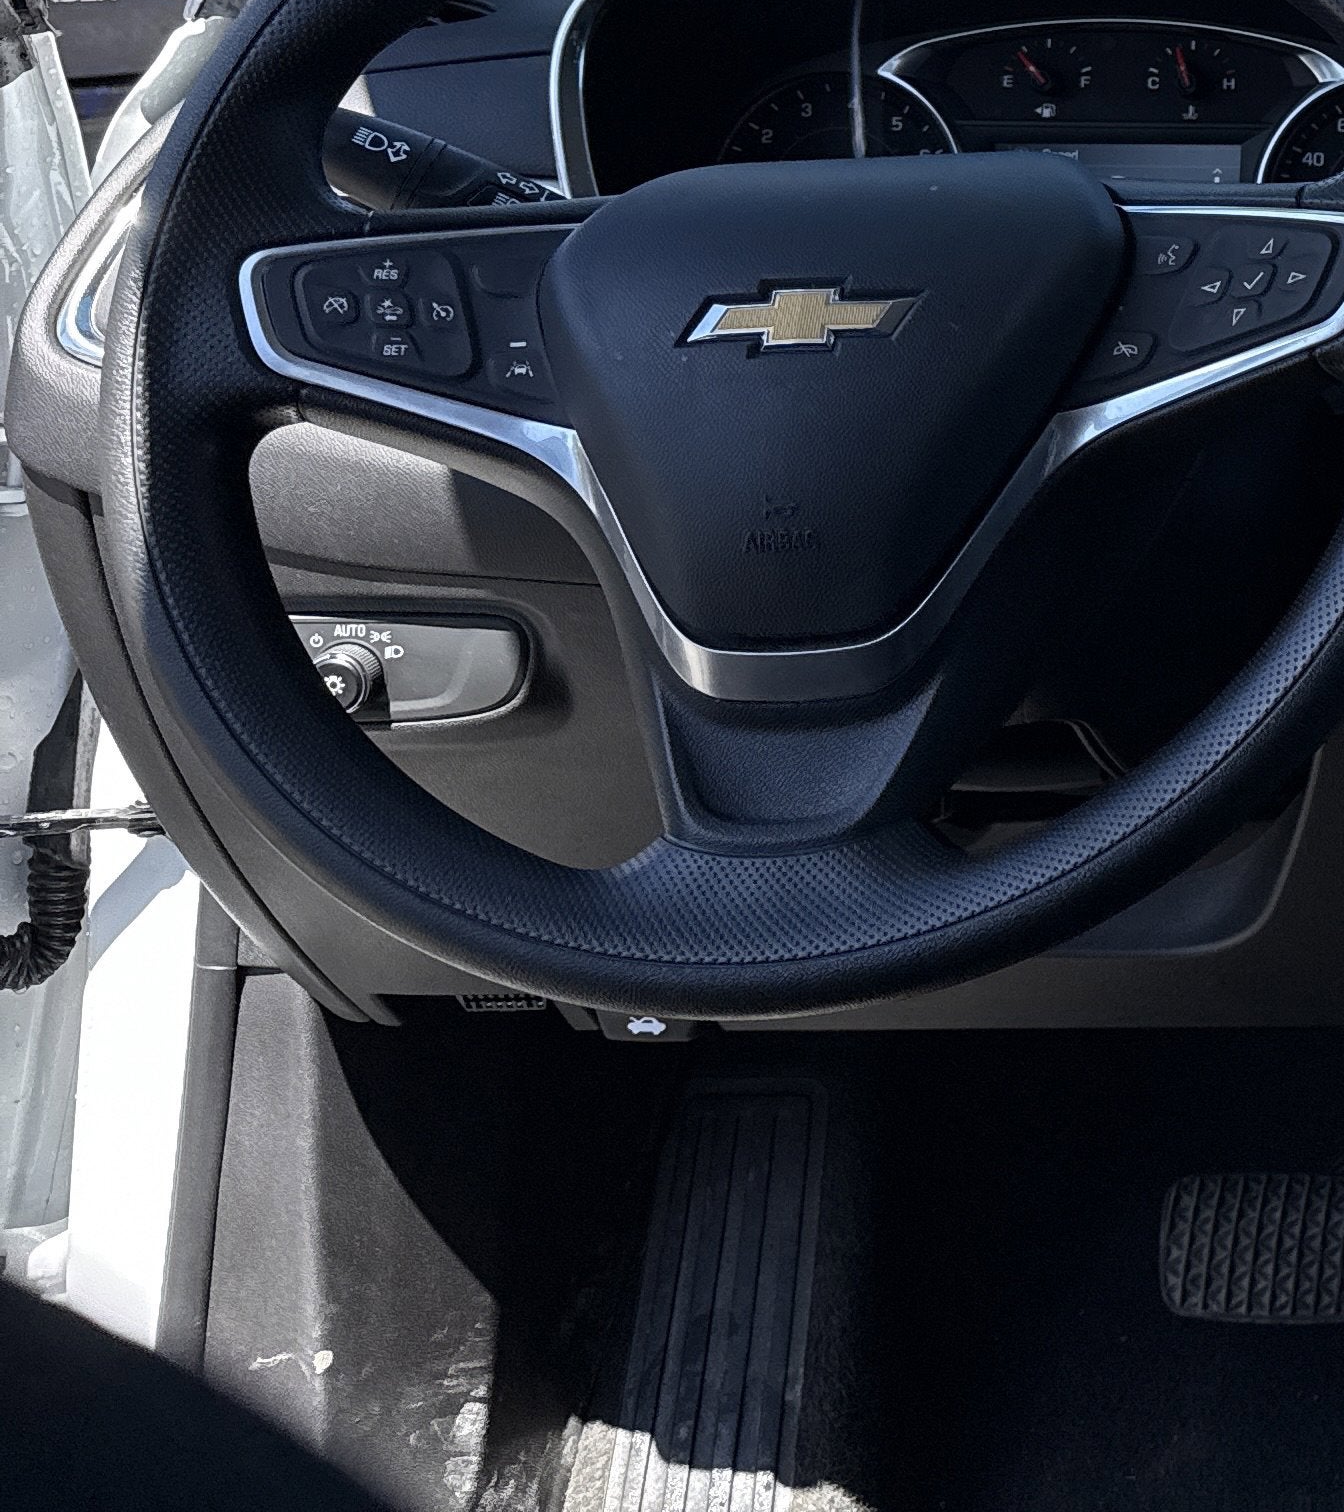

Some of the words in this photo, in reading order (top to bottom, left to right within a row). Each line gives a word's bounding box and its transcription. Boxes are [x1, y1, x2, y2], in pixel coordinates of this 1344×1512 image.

[1002, 74, 1014, 88] E
[1080, 75, 1091, 88] F
[1147, 76, 1160, 90] C
[1223, 78, 1236, 91] H
[801, 102, 813, 118] 3
[891, 116, 904, 132] 5
[762, 128, 774, 144] 2
[1302, 151, 1325, 167] 40
[373, 268, 398, 281] RES
[383, 344, 409, 357] SET
[333, 624, 367, 638] AUTO
